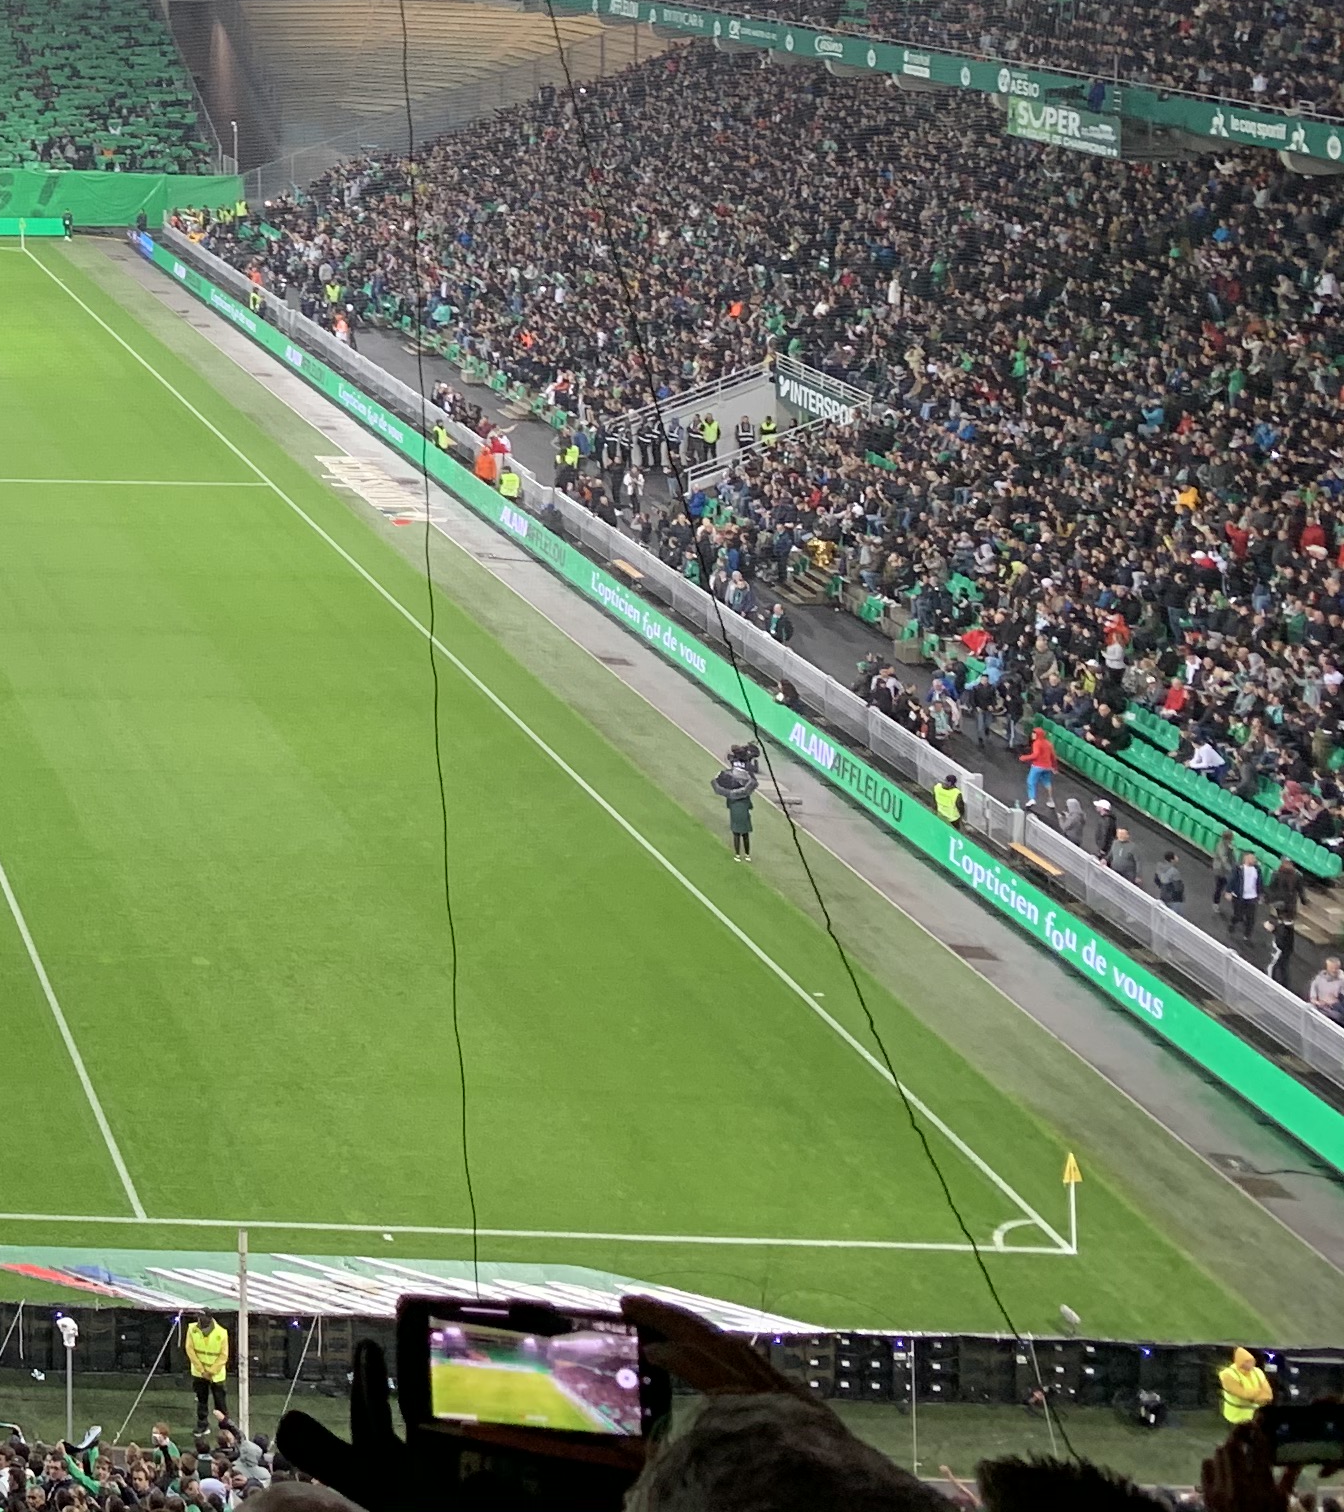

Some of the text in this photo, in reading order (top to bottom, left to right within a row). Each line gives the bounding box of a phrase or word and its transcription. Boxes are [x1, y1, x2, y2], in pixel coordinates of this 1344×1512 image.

[1017, 100, 1081, 138] SUPER
[499, 505, 528, 537] ALAIN
[591, 571, 707, 674] L'opticien fou de vous
[789, 721, 903, 823] ALAIN AFFLELOU
[948, 836, 1164, 1020] L'opticien fou de vous
